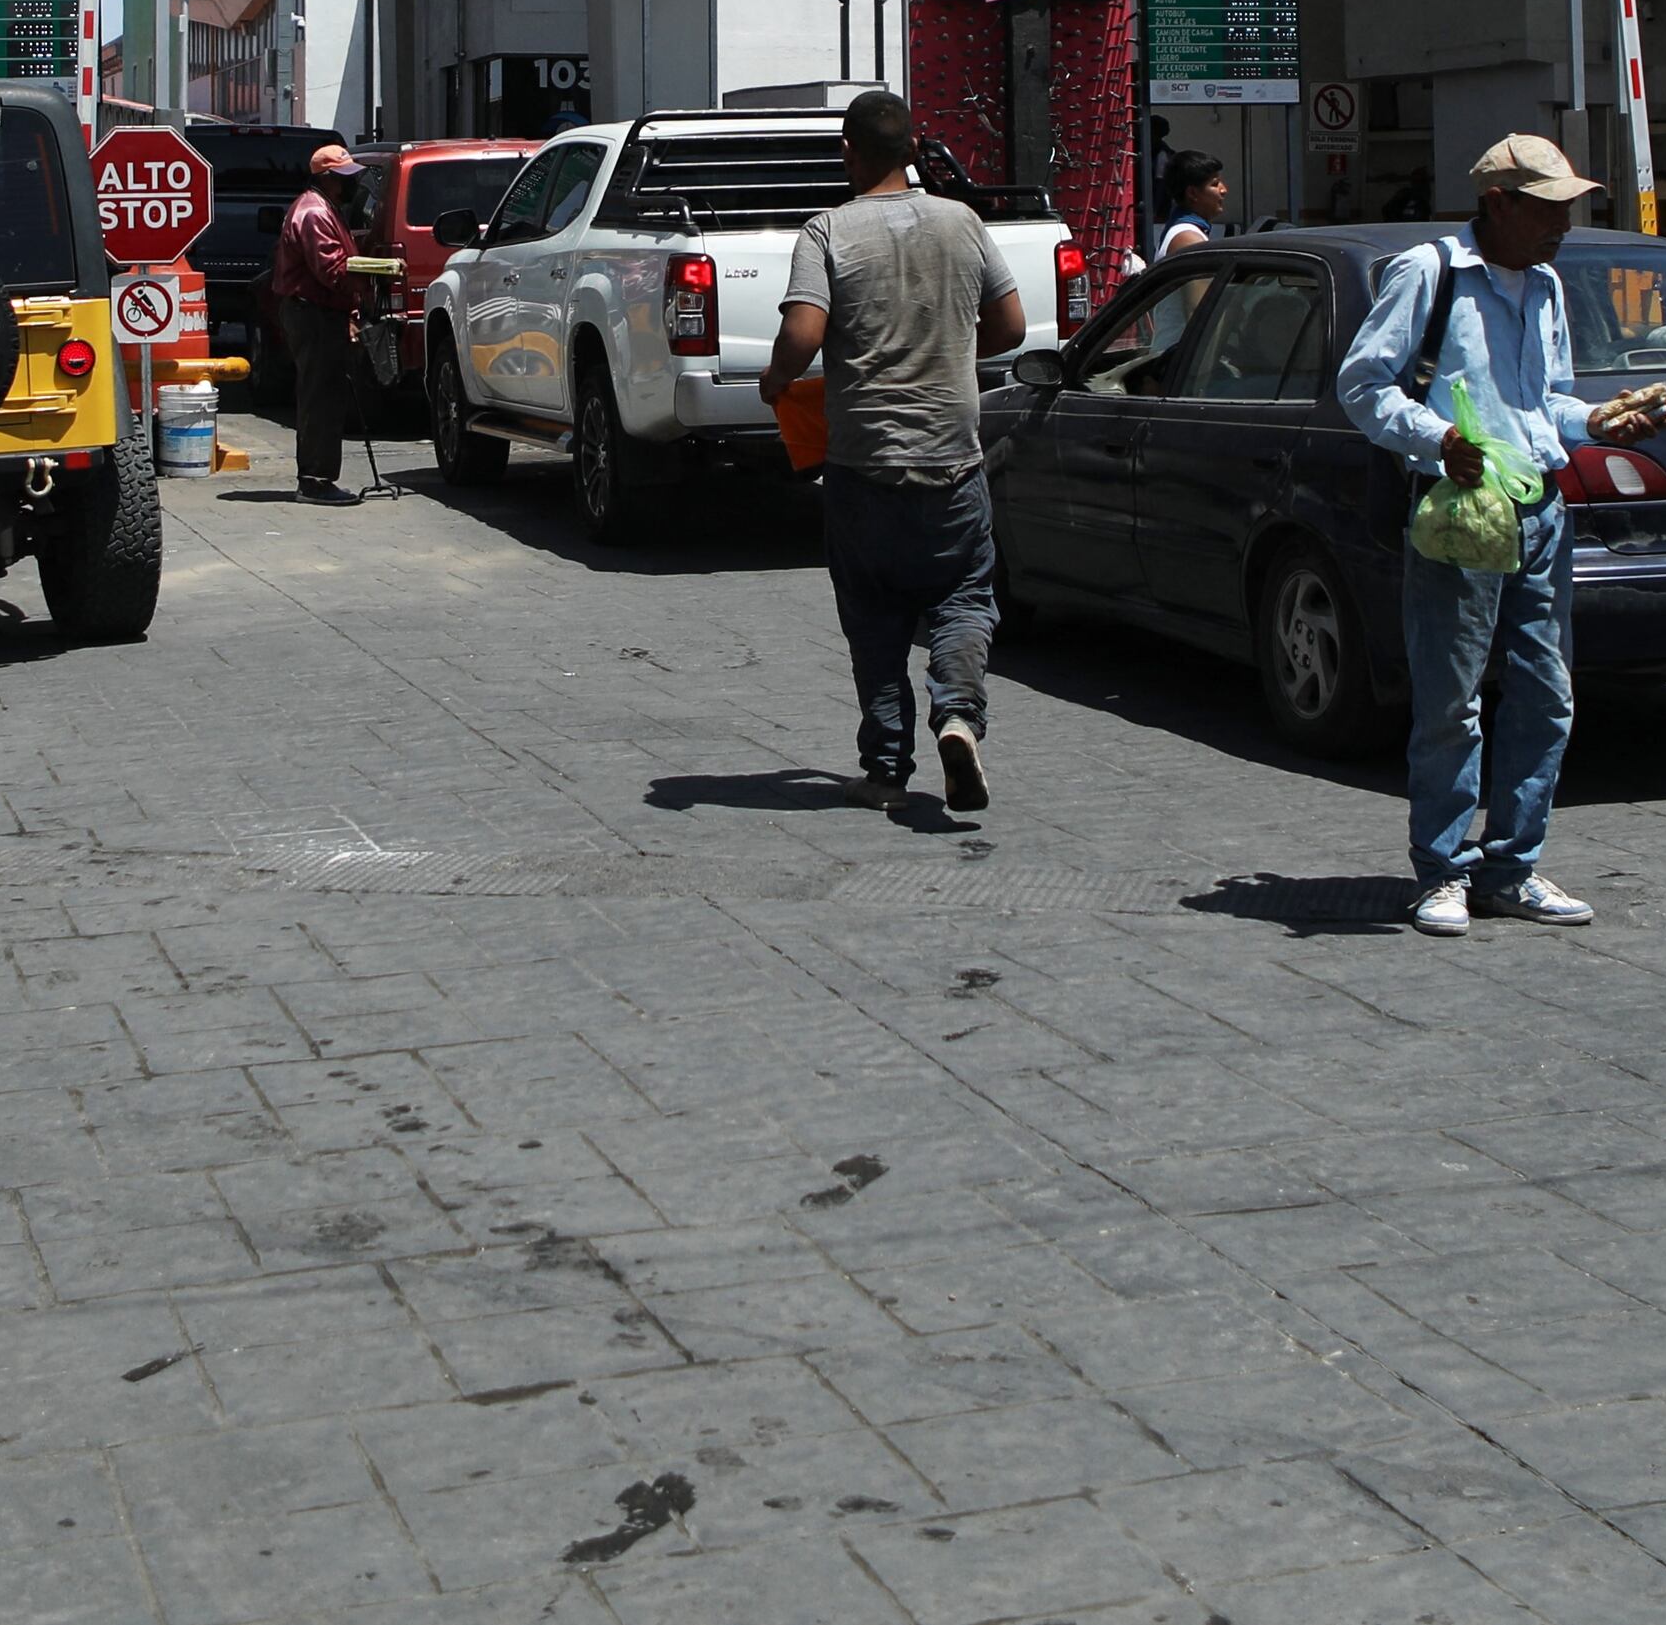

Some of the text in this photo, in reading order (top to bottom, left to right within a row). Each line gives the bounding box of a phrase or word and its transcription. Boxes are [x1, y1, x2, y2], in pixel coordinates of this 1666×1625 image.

[1171, 83, 1190, 91] SCT
[97, 161, 192, 191] ALTO
[99, 200, 193, 229] STOP
